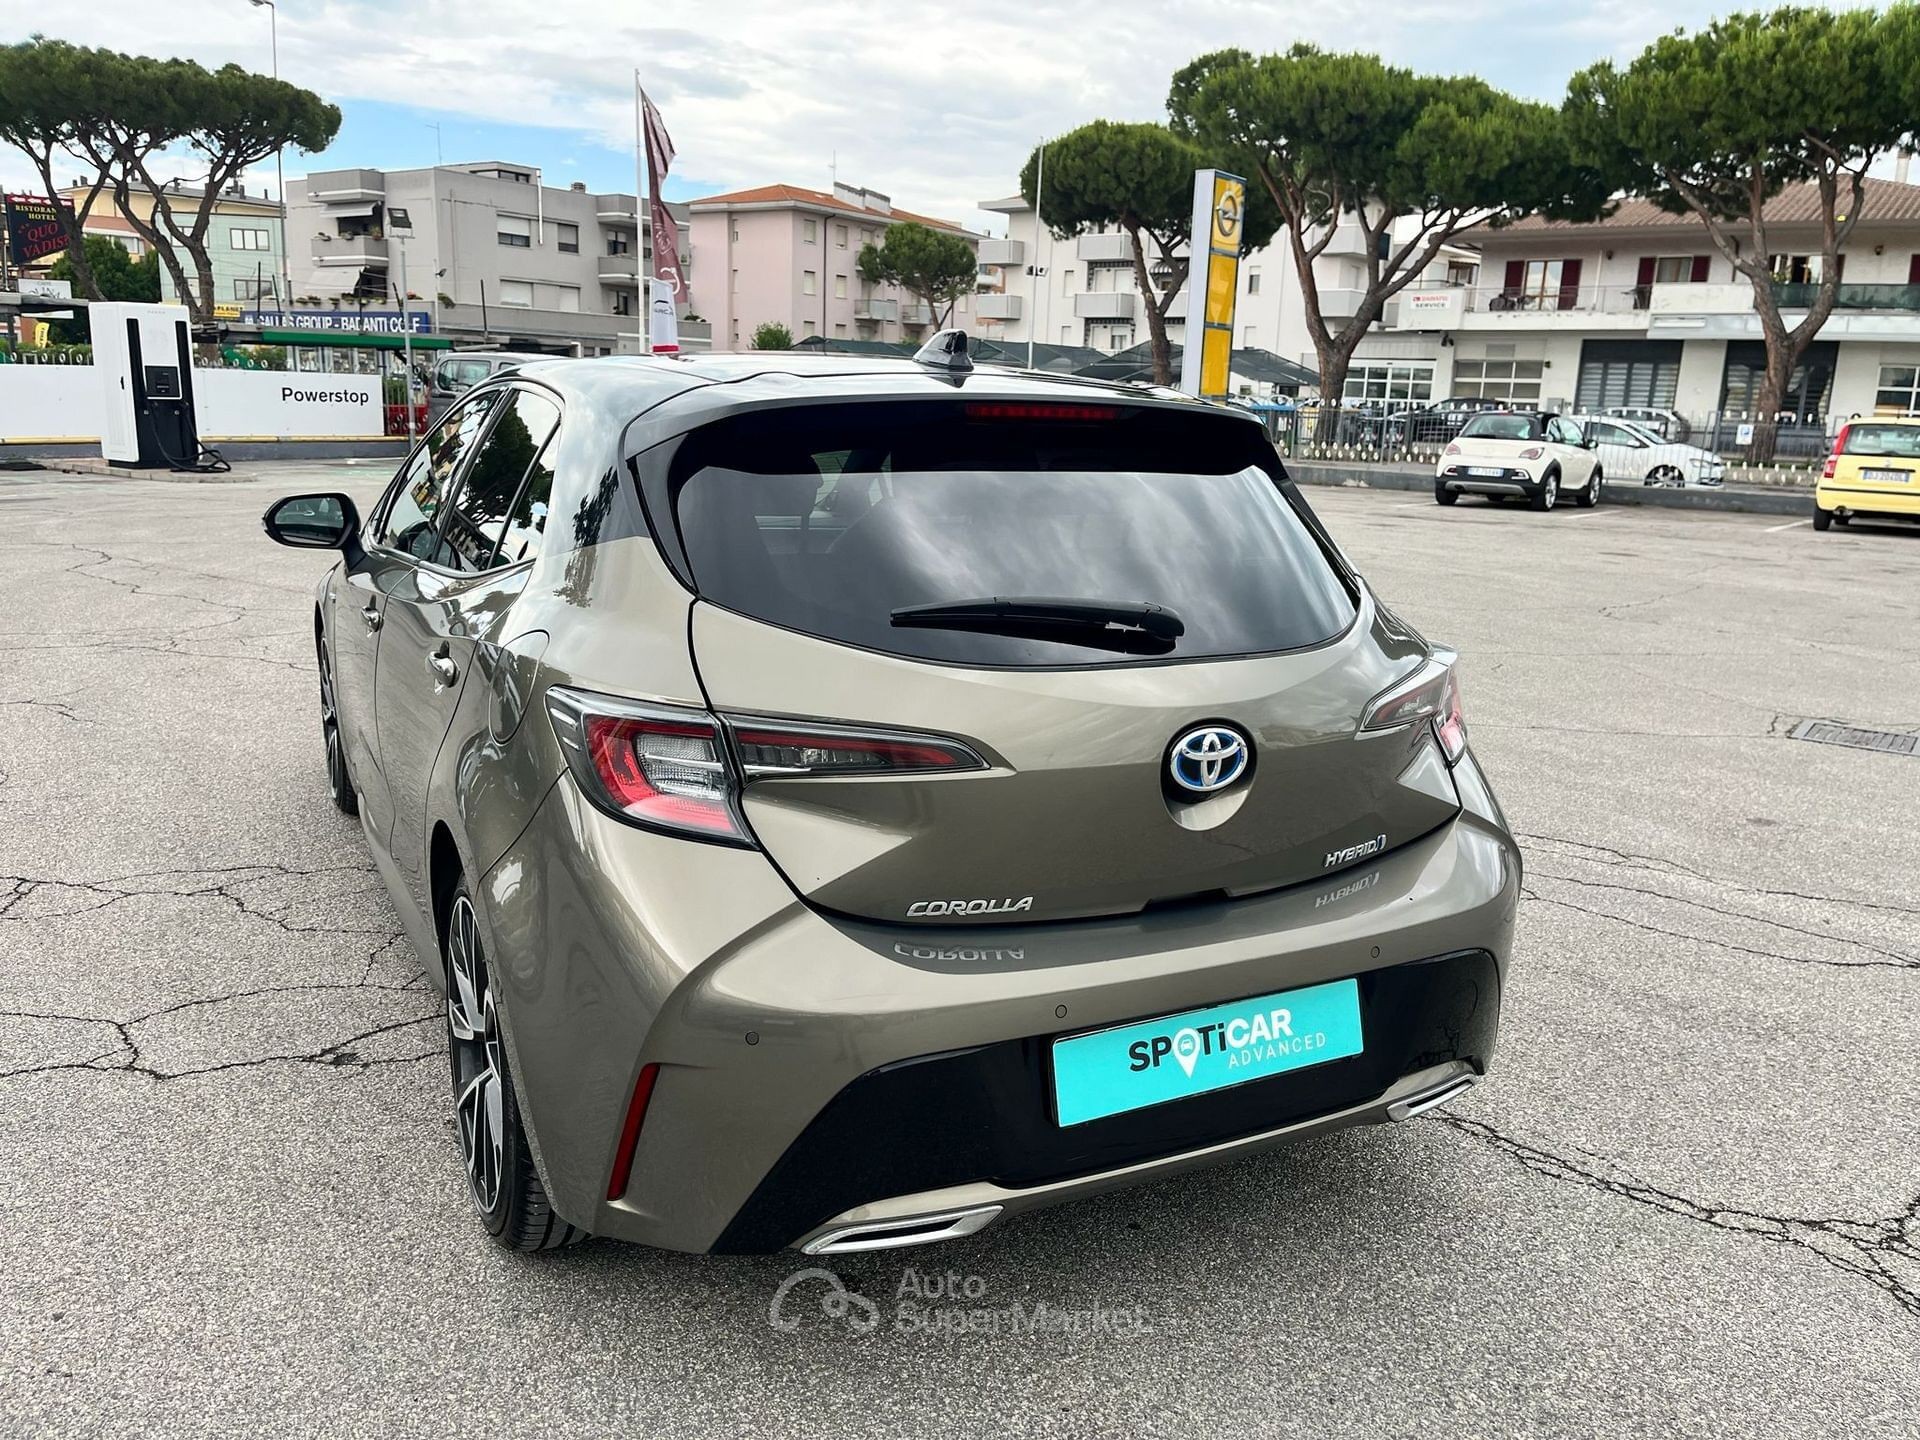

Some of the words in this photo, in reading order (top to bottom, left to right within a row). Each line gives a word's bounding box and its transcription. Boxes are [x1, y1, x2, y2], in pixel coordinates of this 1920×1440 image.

[27, 222, 58, 241] QUO
[296, 316, 333, 330] GROUP
[281, 387, 369, 406] Powerstop
[1324, 839, 1378, 868] HYBRID
[906, 896, 1034, 917] COROLLA
[1228, 1032, 1326, 1069] ADVANCED
